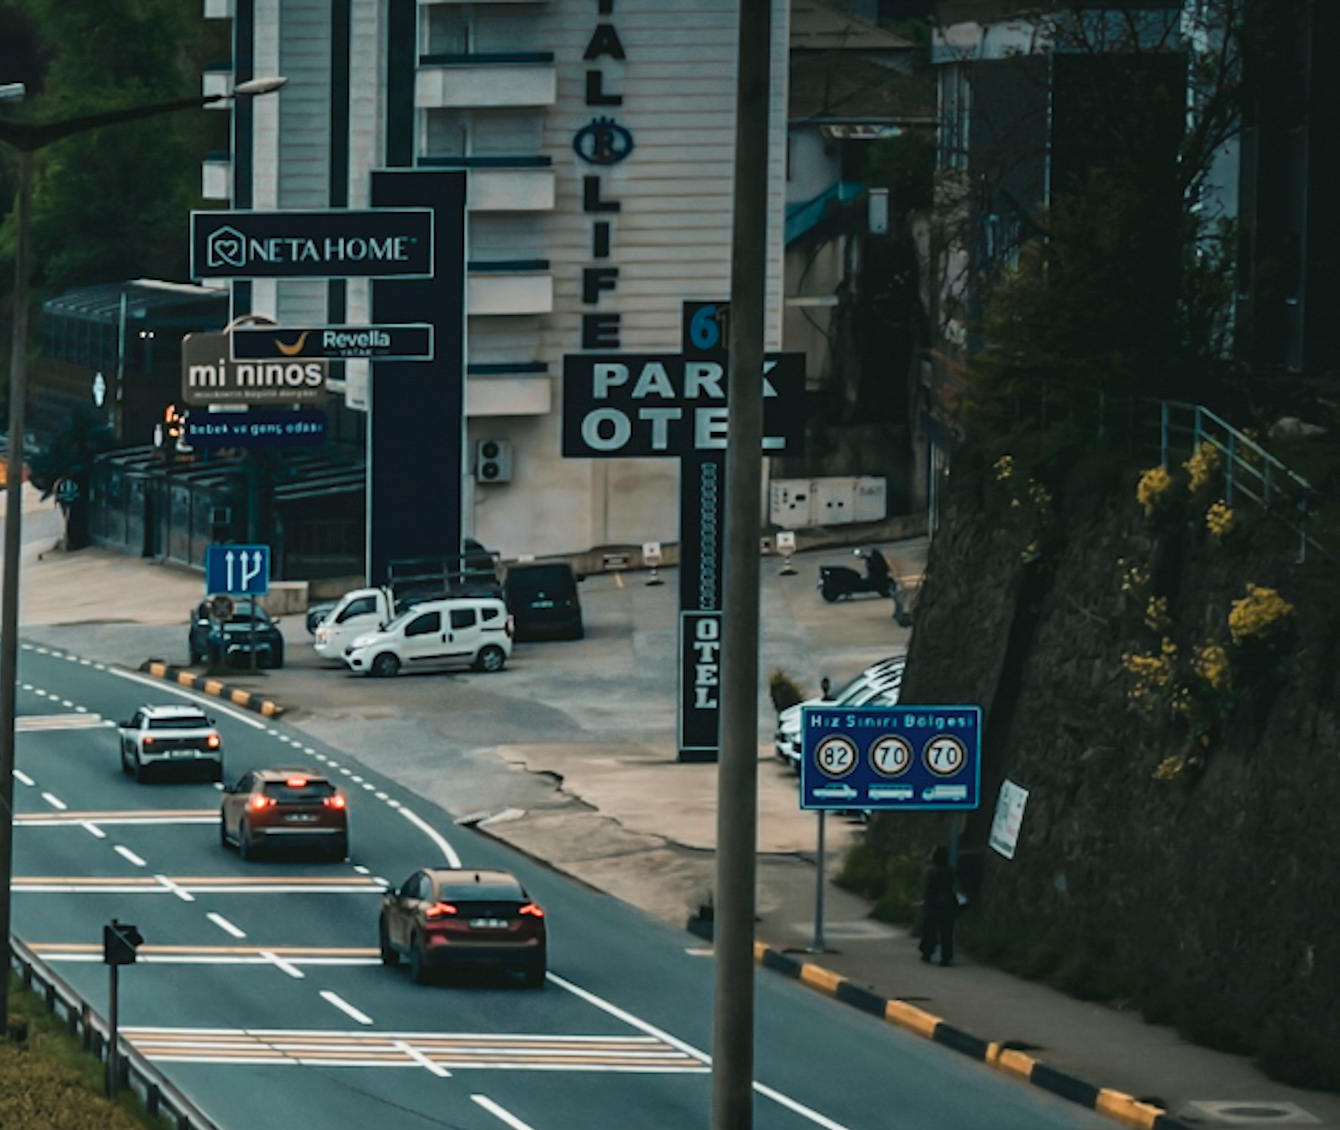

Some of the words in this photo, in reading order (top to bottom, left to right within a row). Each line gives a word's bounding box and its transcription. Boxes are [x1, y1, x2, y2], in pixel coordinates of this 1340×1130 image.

[249, 239, 320, 262] NETA
[323, 237, 408, 261] HOME
[581, 175, 621, 350] LIFE
[323, 331, 391, 348] Revella
[188, 358, 226, 387] mi
[236, 361, 323, 387] ninos
[694, 618, 720, 709] OTEL
[823, 747, 849, 766] 82
[879, 747, 906, 766] 70
[932, 747, 959, 766] 70
